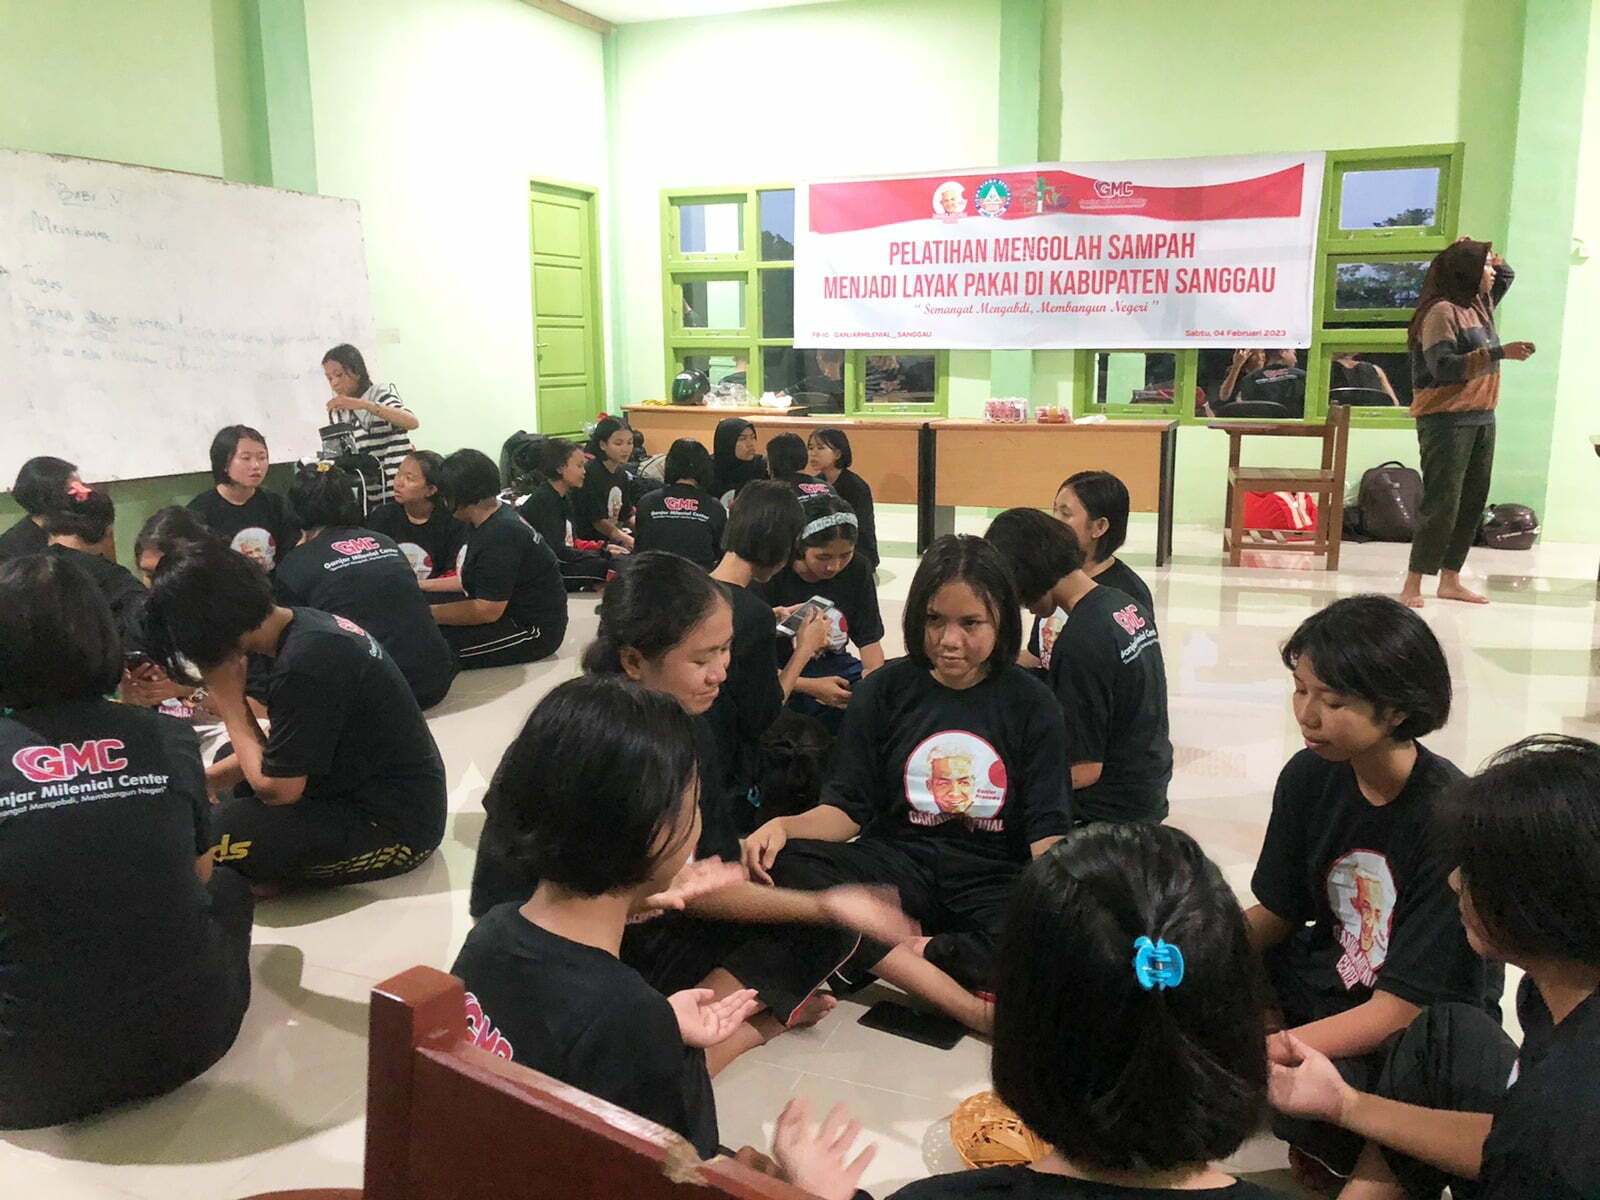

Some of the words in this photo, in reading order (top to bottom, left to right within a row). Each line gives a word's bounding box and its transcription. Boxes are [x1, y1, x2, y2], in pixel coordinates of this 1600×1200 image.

[889, 239, 988, 266] PELATIHAN
[993, 234, 1101, 262] MENGOLAH
[1107, 232, 1196, 260] SAMPAH
[823, 275, 897, 299] MENJADI
[902, 273, 959, 298] LAYAK
[964, 271, 1019, 297] PAKAI
[1024, 271, 1044, 296] DI
[1049, 269, 1169, 296] KABUPATEN
[1175, 266, 1277, 294] SANGGAU
[1213, 329, 1225, 337] 04
[1226, 329, 1262, 337] Februari
[1263, 329, 1287, 337] 2023
[663, 496, 699, 511] GMC
[330, 536, 380, 556] GMC
[12, 738, 129, 783] GMC
[0, 790, 37, 808] njar
[40, 776, 115, 799] Milenial
[118, 773, 170, 788] Center
